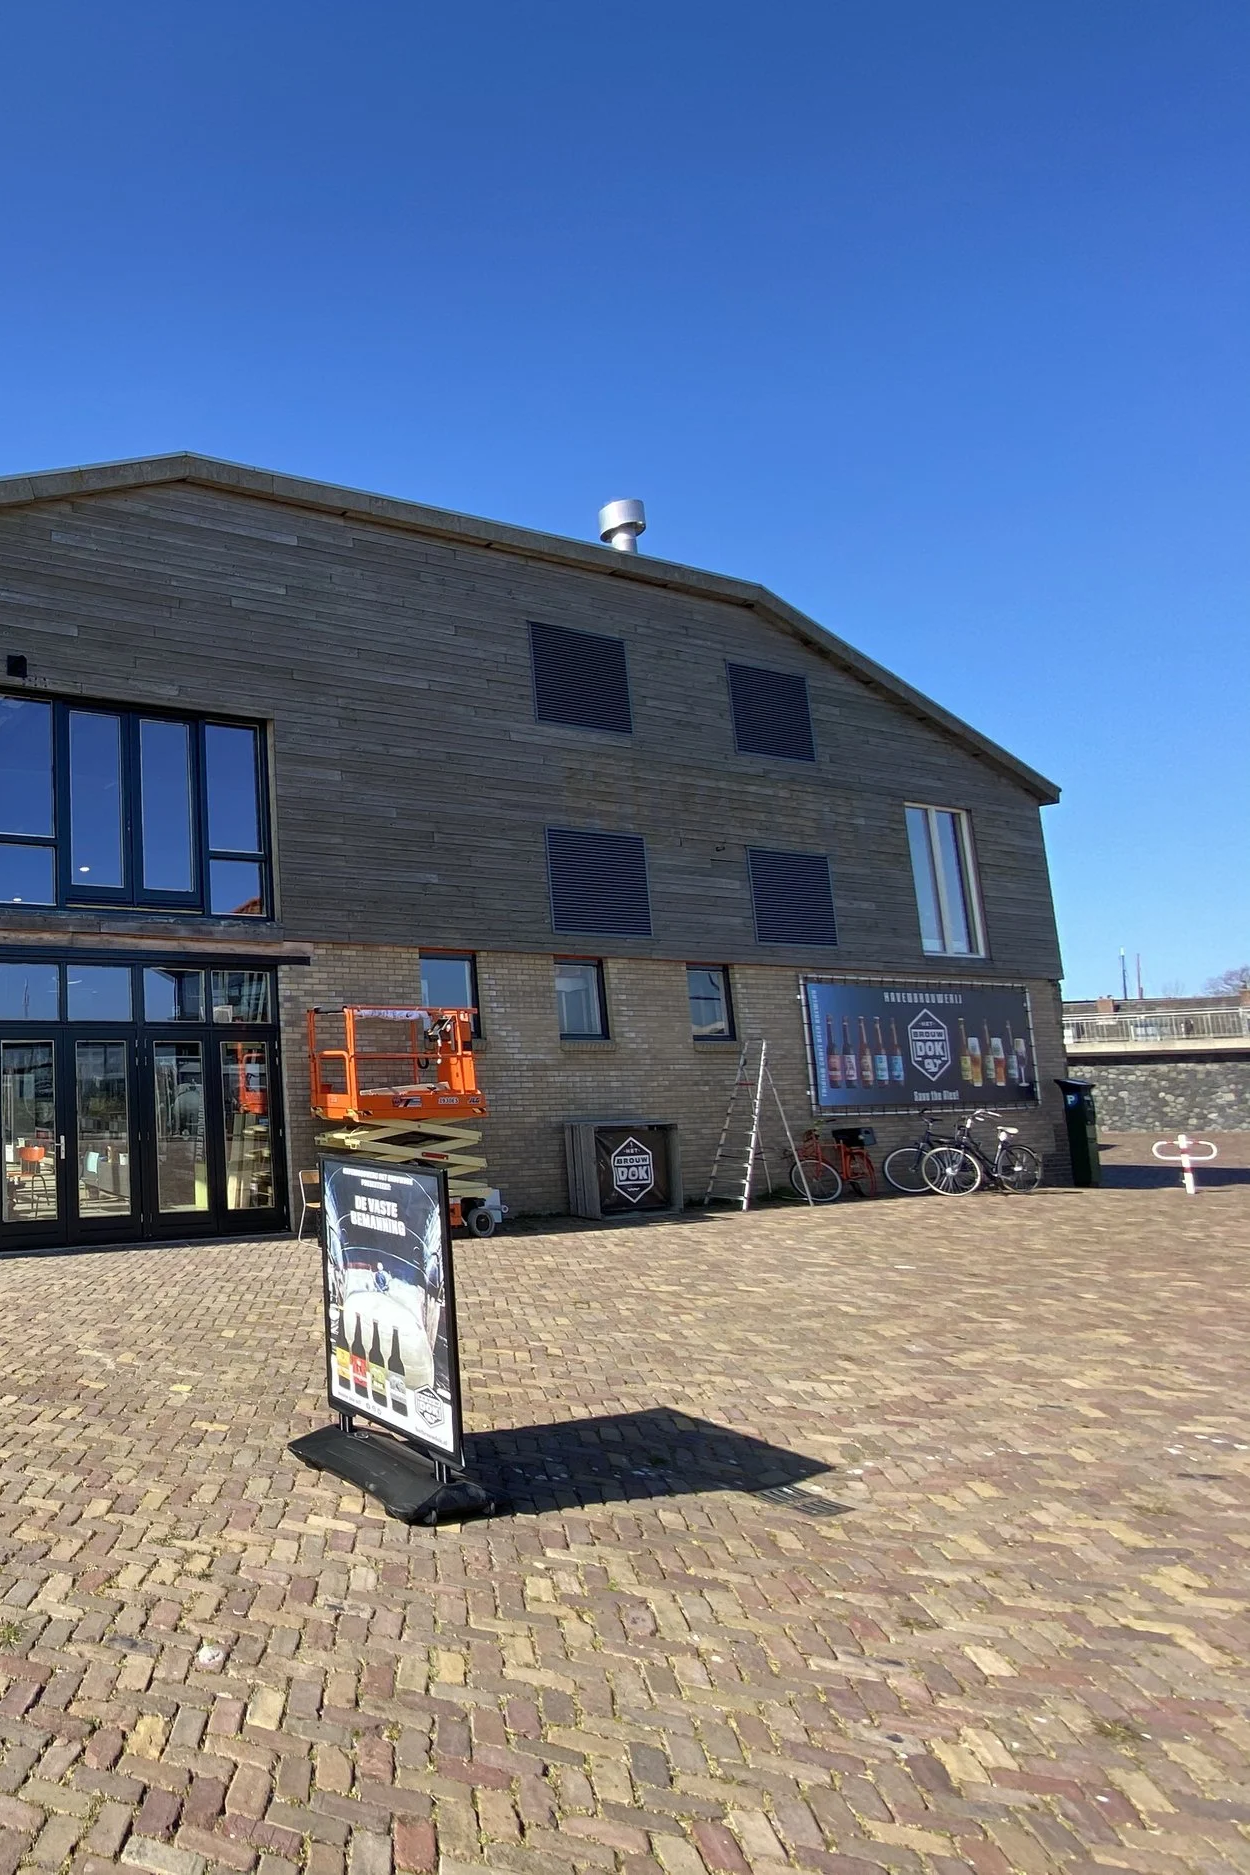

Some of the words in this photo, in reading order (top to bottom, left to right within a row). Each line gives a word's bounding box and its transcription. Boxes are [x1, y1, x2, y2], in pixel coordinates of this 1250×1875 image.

[883, 991, 963, 1004] HAVENBROUWERIJ
[915, 1041, 945, 1056] DOK
[930, 1090, 942, 1101] the
[1066, 1094, 1075, 1105] P
[616, 1157, 648, 1165] BROUW
[617, 1165, 648, 1181] DOK
[354, 1194, 368, 1212] DE
[367, 1197, 398, 1219] VASTE
[350, 1209, 407, 1237] BEMANNING
